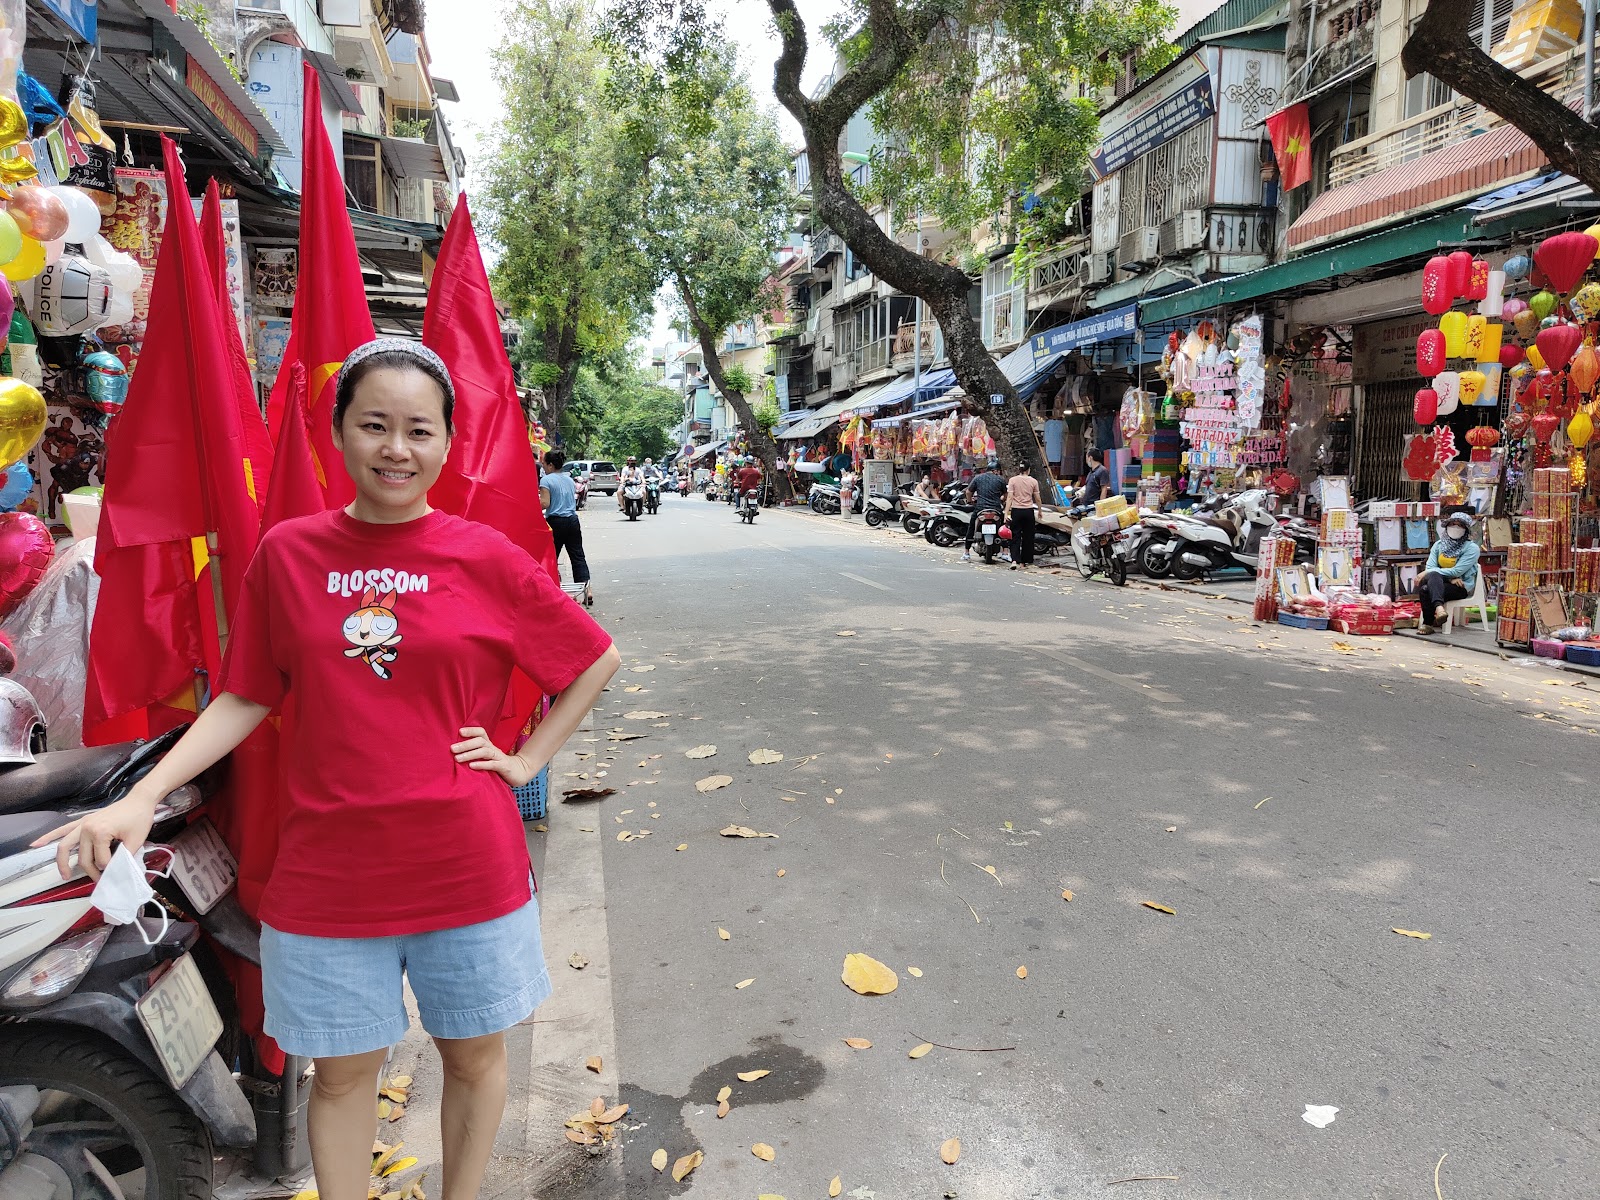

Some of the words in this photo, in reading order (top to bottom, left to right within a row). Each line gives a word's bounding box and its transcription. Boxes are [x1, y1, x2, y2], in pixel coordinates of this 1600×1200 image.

[40, 265, 54, 322] POLICE
[1036, 335, 1045, 349] 19
[992, 395, 1001, 403] 19
[1181, 450, 1237, 465] BIRTHDAY
[327, 568, 429, 598] BLOSSOM
